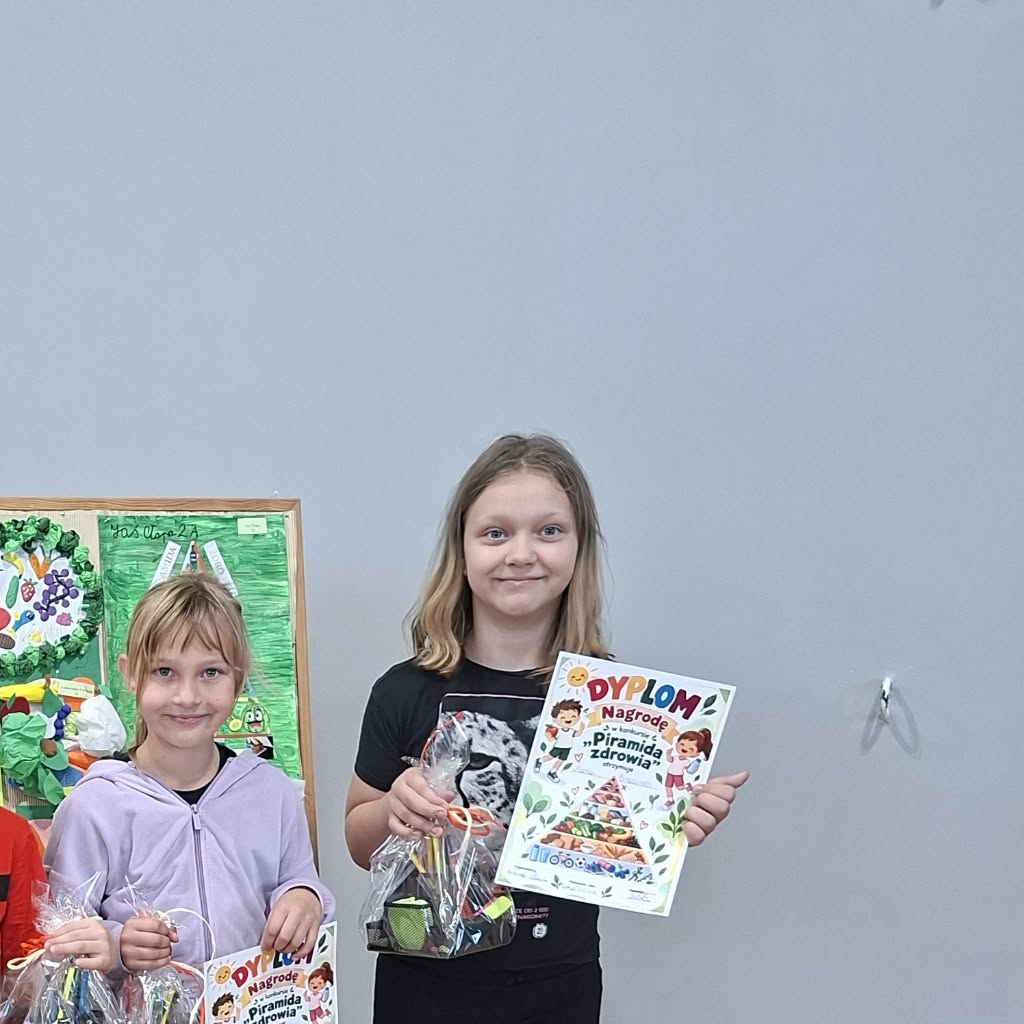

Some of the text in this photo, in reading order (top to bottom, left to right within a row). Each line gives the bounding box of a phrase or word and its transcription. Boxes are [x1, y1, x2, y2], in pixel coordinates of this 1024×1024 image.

[587, 675, 702, 721] DYPLOM
[601, 705, 669, 733] Nagrodę
[583, 731, 664, 760] „Piramida
[589, 747, 661, 771] zdrowia”
[247, 969, 299, 997] Nagrodę
